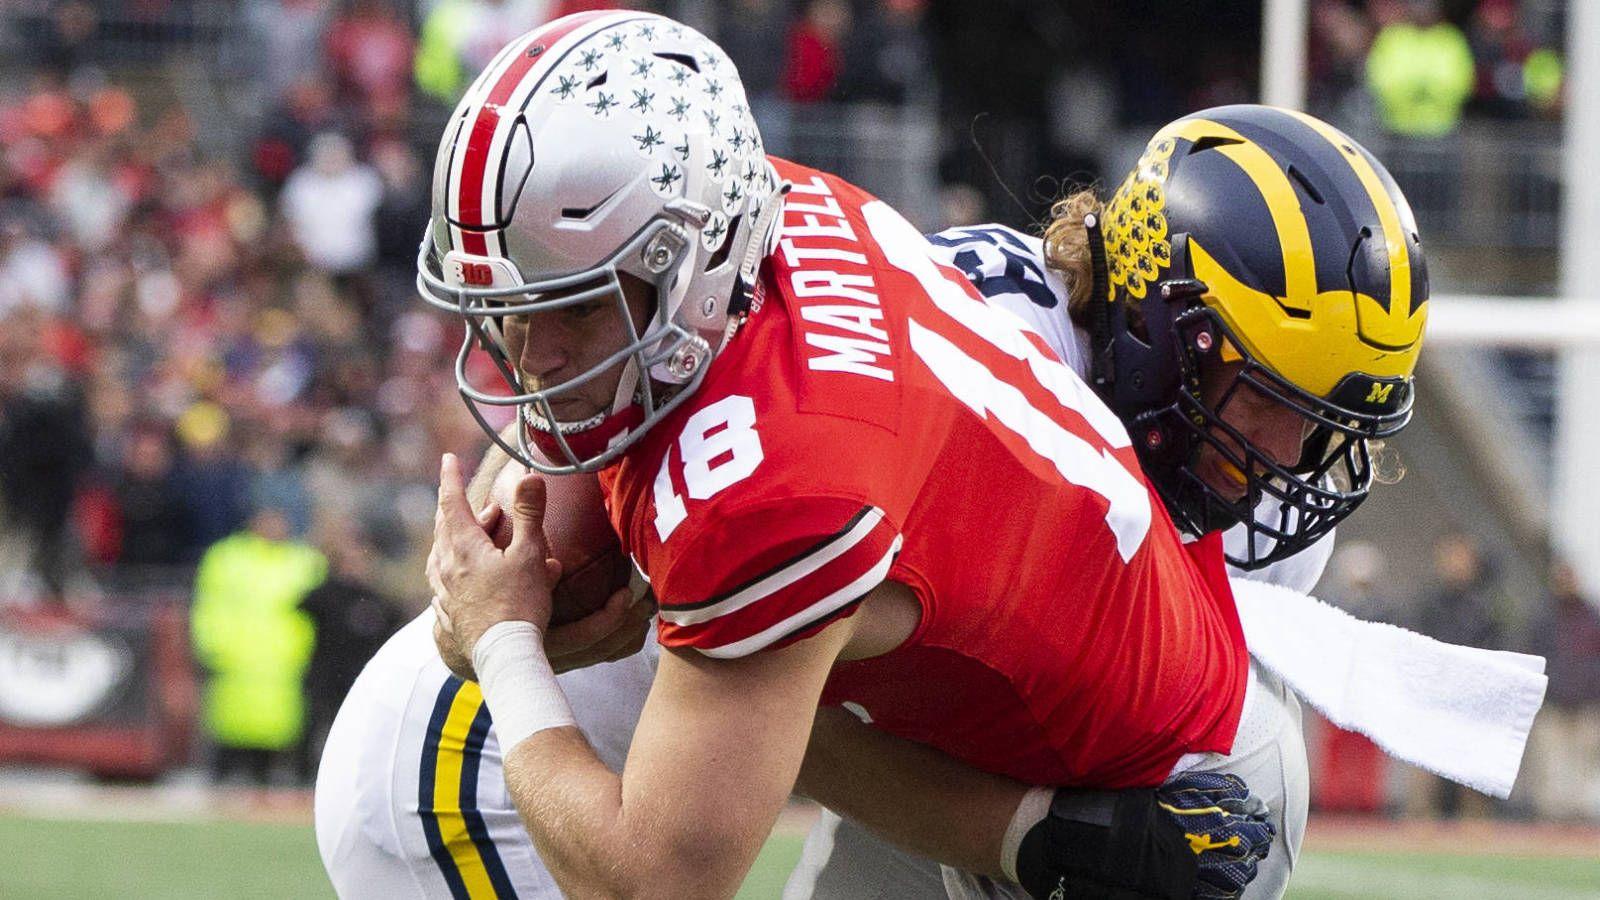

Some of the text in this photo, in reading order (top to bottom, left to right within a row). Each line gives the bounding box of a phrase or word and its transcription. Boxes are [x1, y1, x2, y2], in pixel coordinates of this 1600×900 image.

[780, 176, 895, 382] MARTELL
[1365, 382, 1394, 404] M
[653, 394, 766, 544] 18
